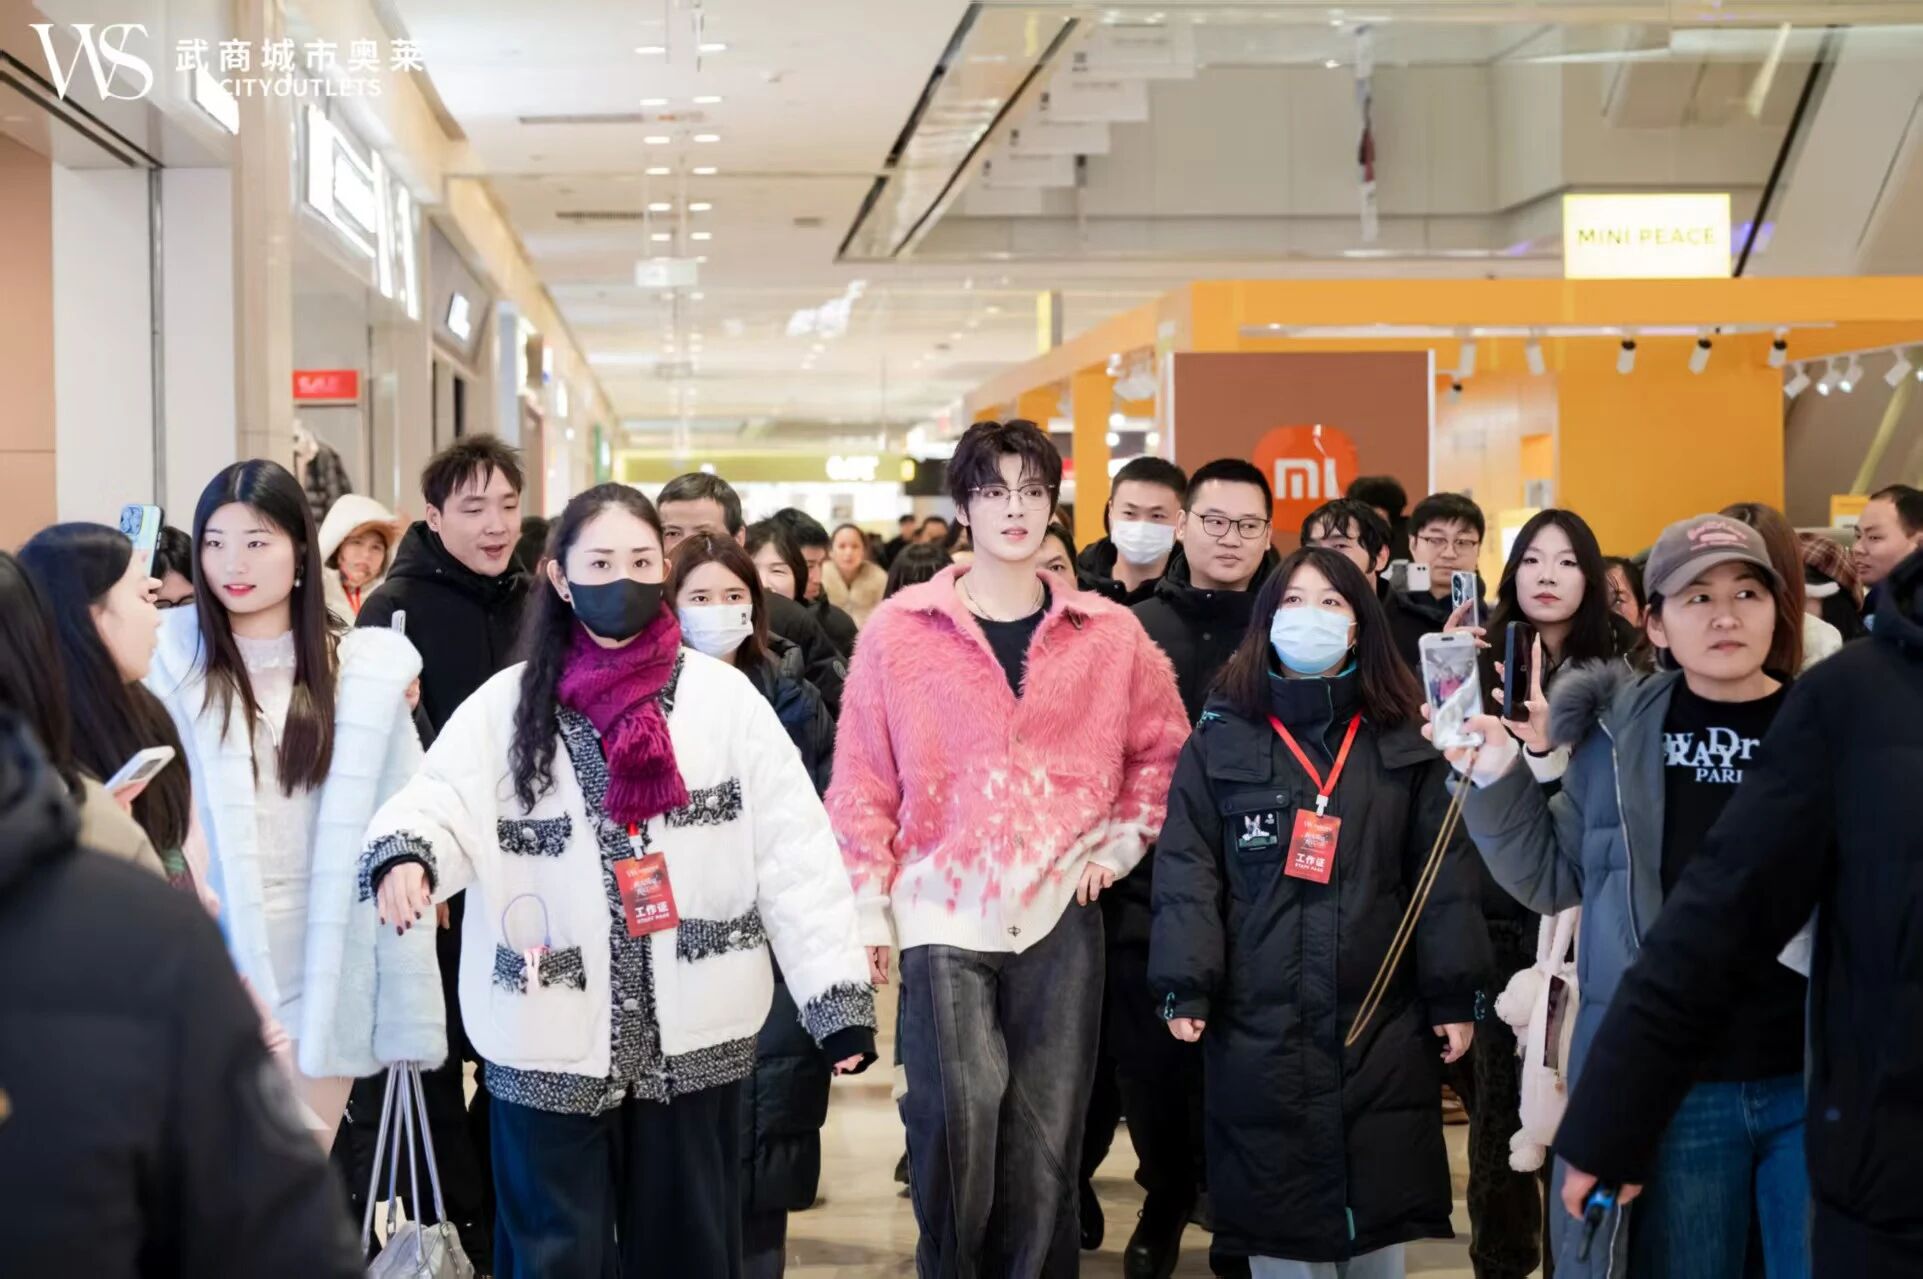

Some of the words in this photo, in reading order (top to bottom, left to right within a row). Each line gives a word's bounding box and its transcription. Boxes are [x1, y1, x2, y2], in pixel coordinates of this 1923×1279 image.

[1578, 229, 1631, 245] MINI
[1640, 228, 1714, 245] PEACE
[1295, 853, 1326, 867] 工作证
[635, 901, 669, 919] 工作证
